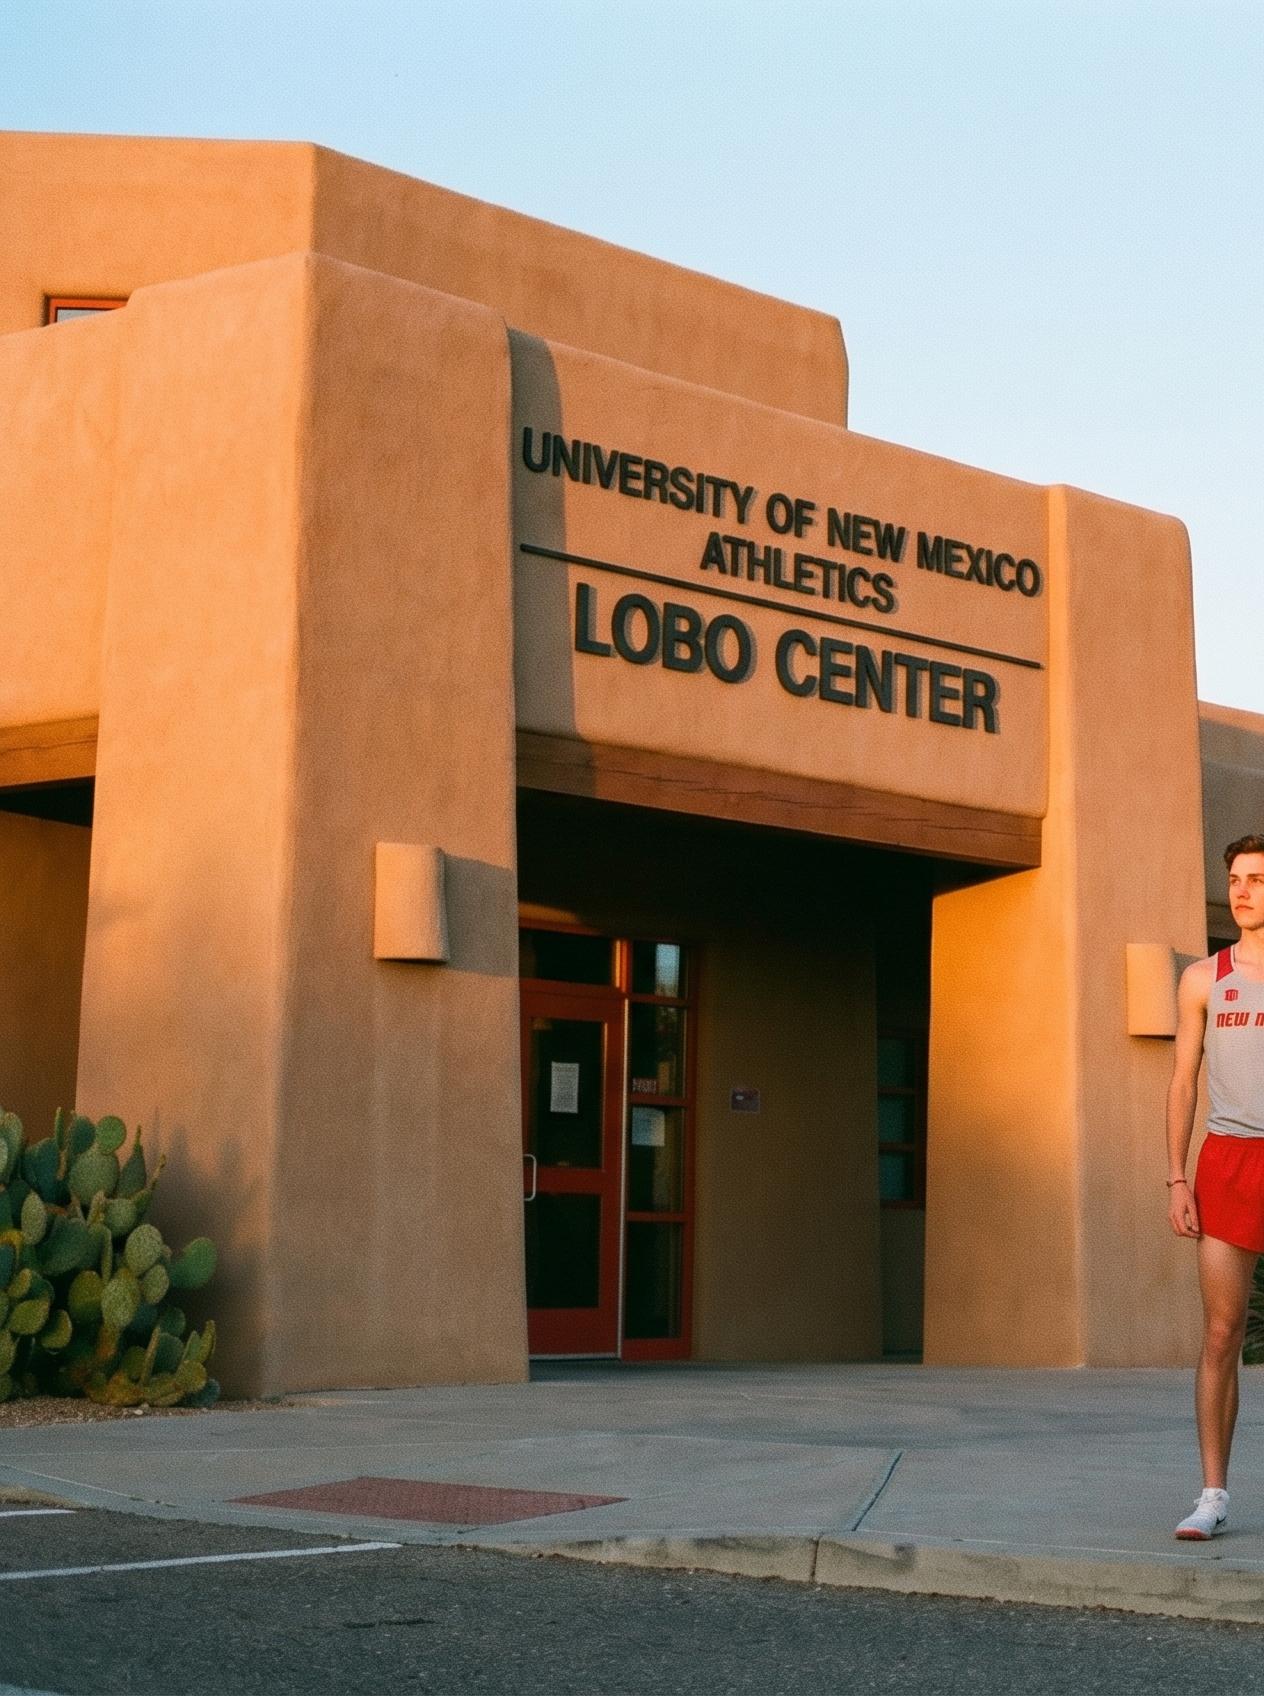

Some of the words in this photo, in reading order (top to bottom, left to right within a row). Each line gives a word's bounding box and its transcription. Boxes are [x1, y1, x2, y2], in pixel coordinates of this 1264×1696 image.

[522, 426, 755, 525] UNIVERSITY
[766, 493, 815, 538] OF
[827, 508, 906, 562] NEW
[917, 531, 1042, 597] MEXICO
[700, 531, 896, 614] ATHLETICS
[575, 582, 753, 684] LOBO
[775, 629, 999, 734] CENTER
[1216, 1012, 1250, 1028] NEW
